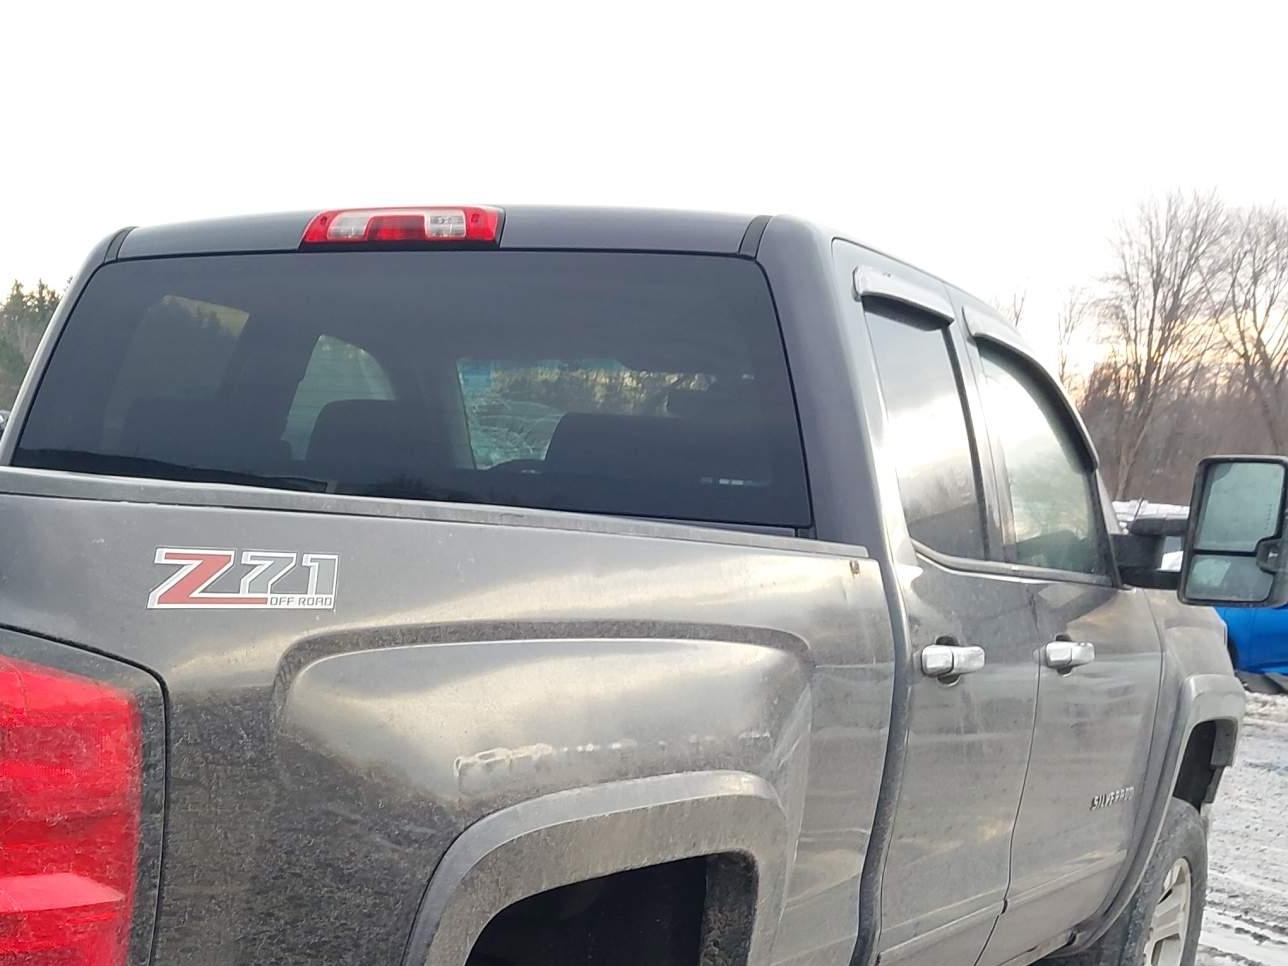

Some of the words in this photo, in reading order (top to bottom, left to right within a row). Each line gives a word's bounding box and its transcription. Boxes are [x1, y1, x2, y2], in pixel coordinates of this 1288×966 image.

[147, 547, 339, 609] Z71
[270, 596, 295, 606] OFF
[298, 596, 332, 607] ROAD
